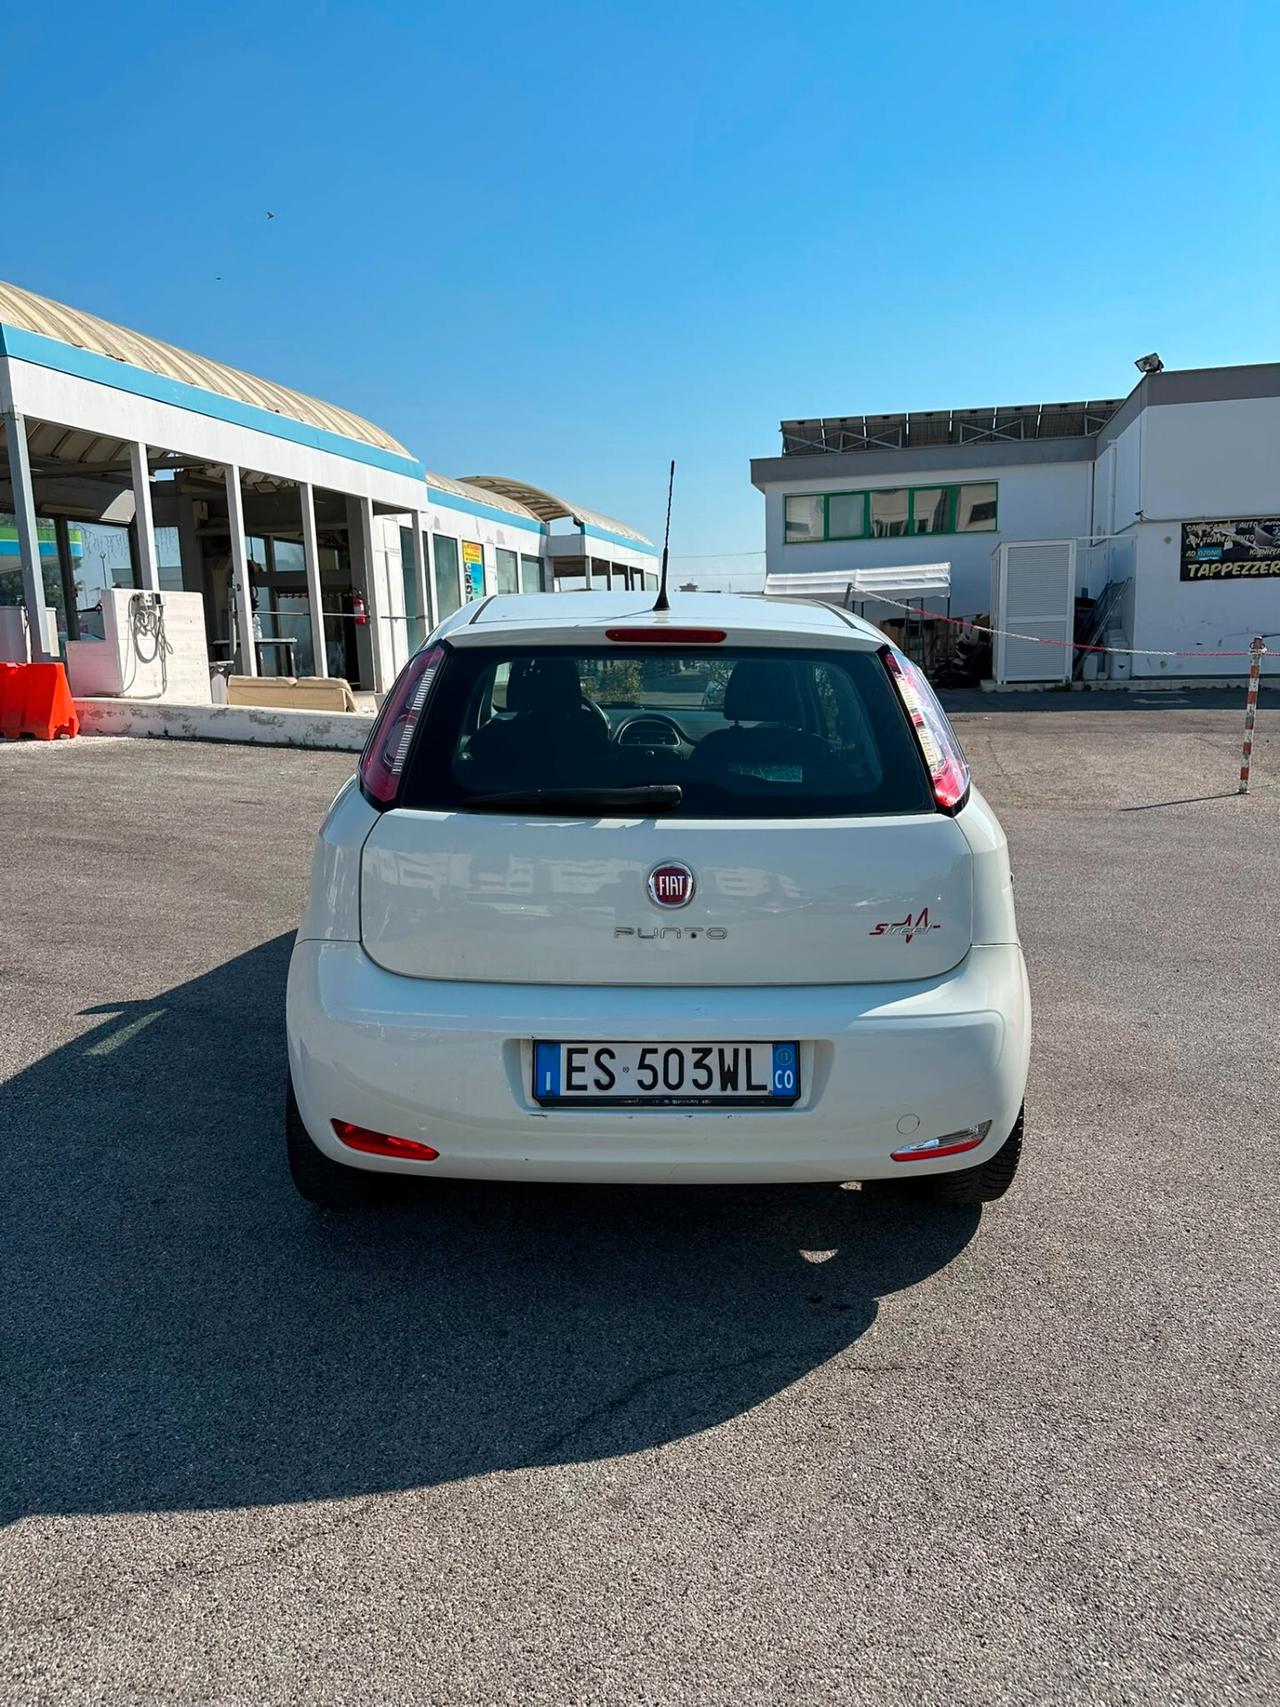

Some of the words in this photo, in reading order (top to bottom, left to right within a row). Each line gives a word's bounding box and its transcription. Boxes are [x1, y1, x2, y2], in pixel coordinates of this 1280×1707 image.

[1239, 521, 1259, 529] AUTO
[659, 875, 685, 896] FIAT
[614, 927, 728, 940] PUNTO
[566, 1048, 616, 1091] ES
[637, 1048, 768, 1091] 503WL
[775, 1070, 793, 1089] CO
